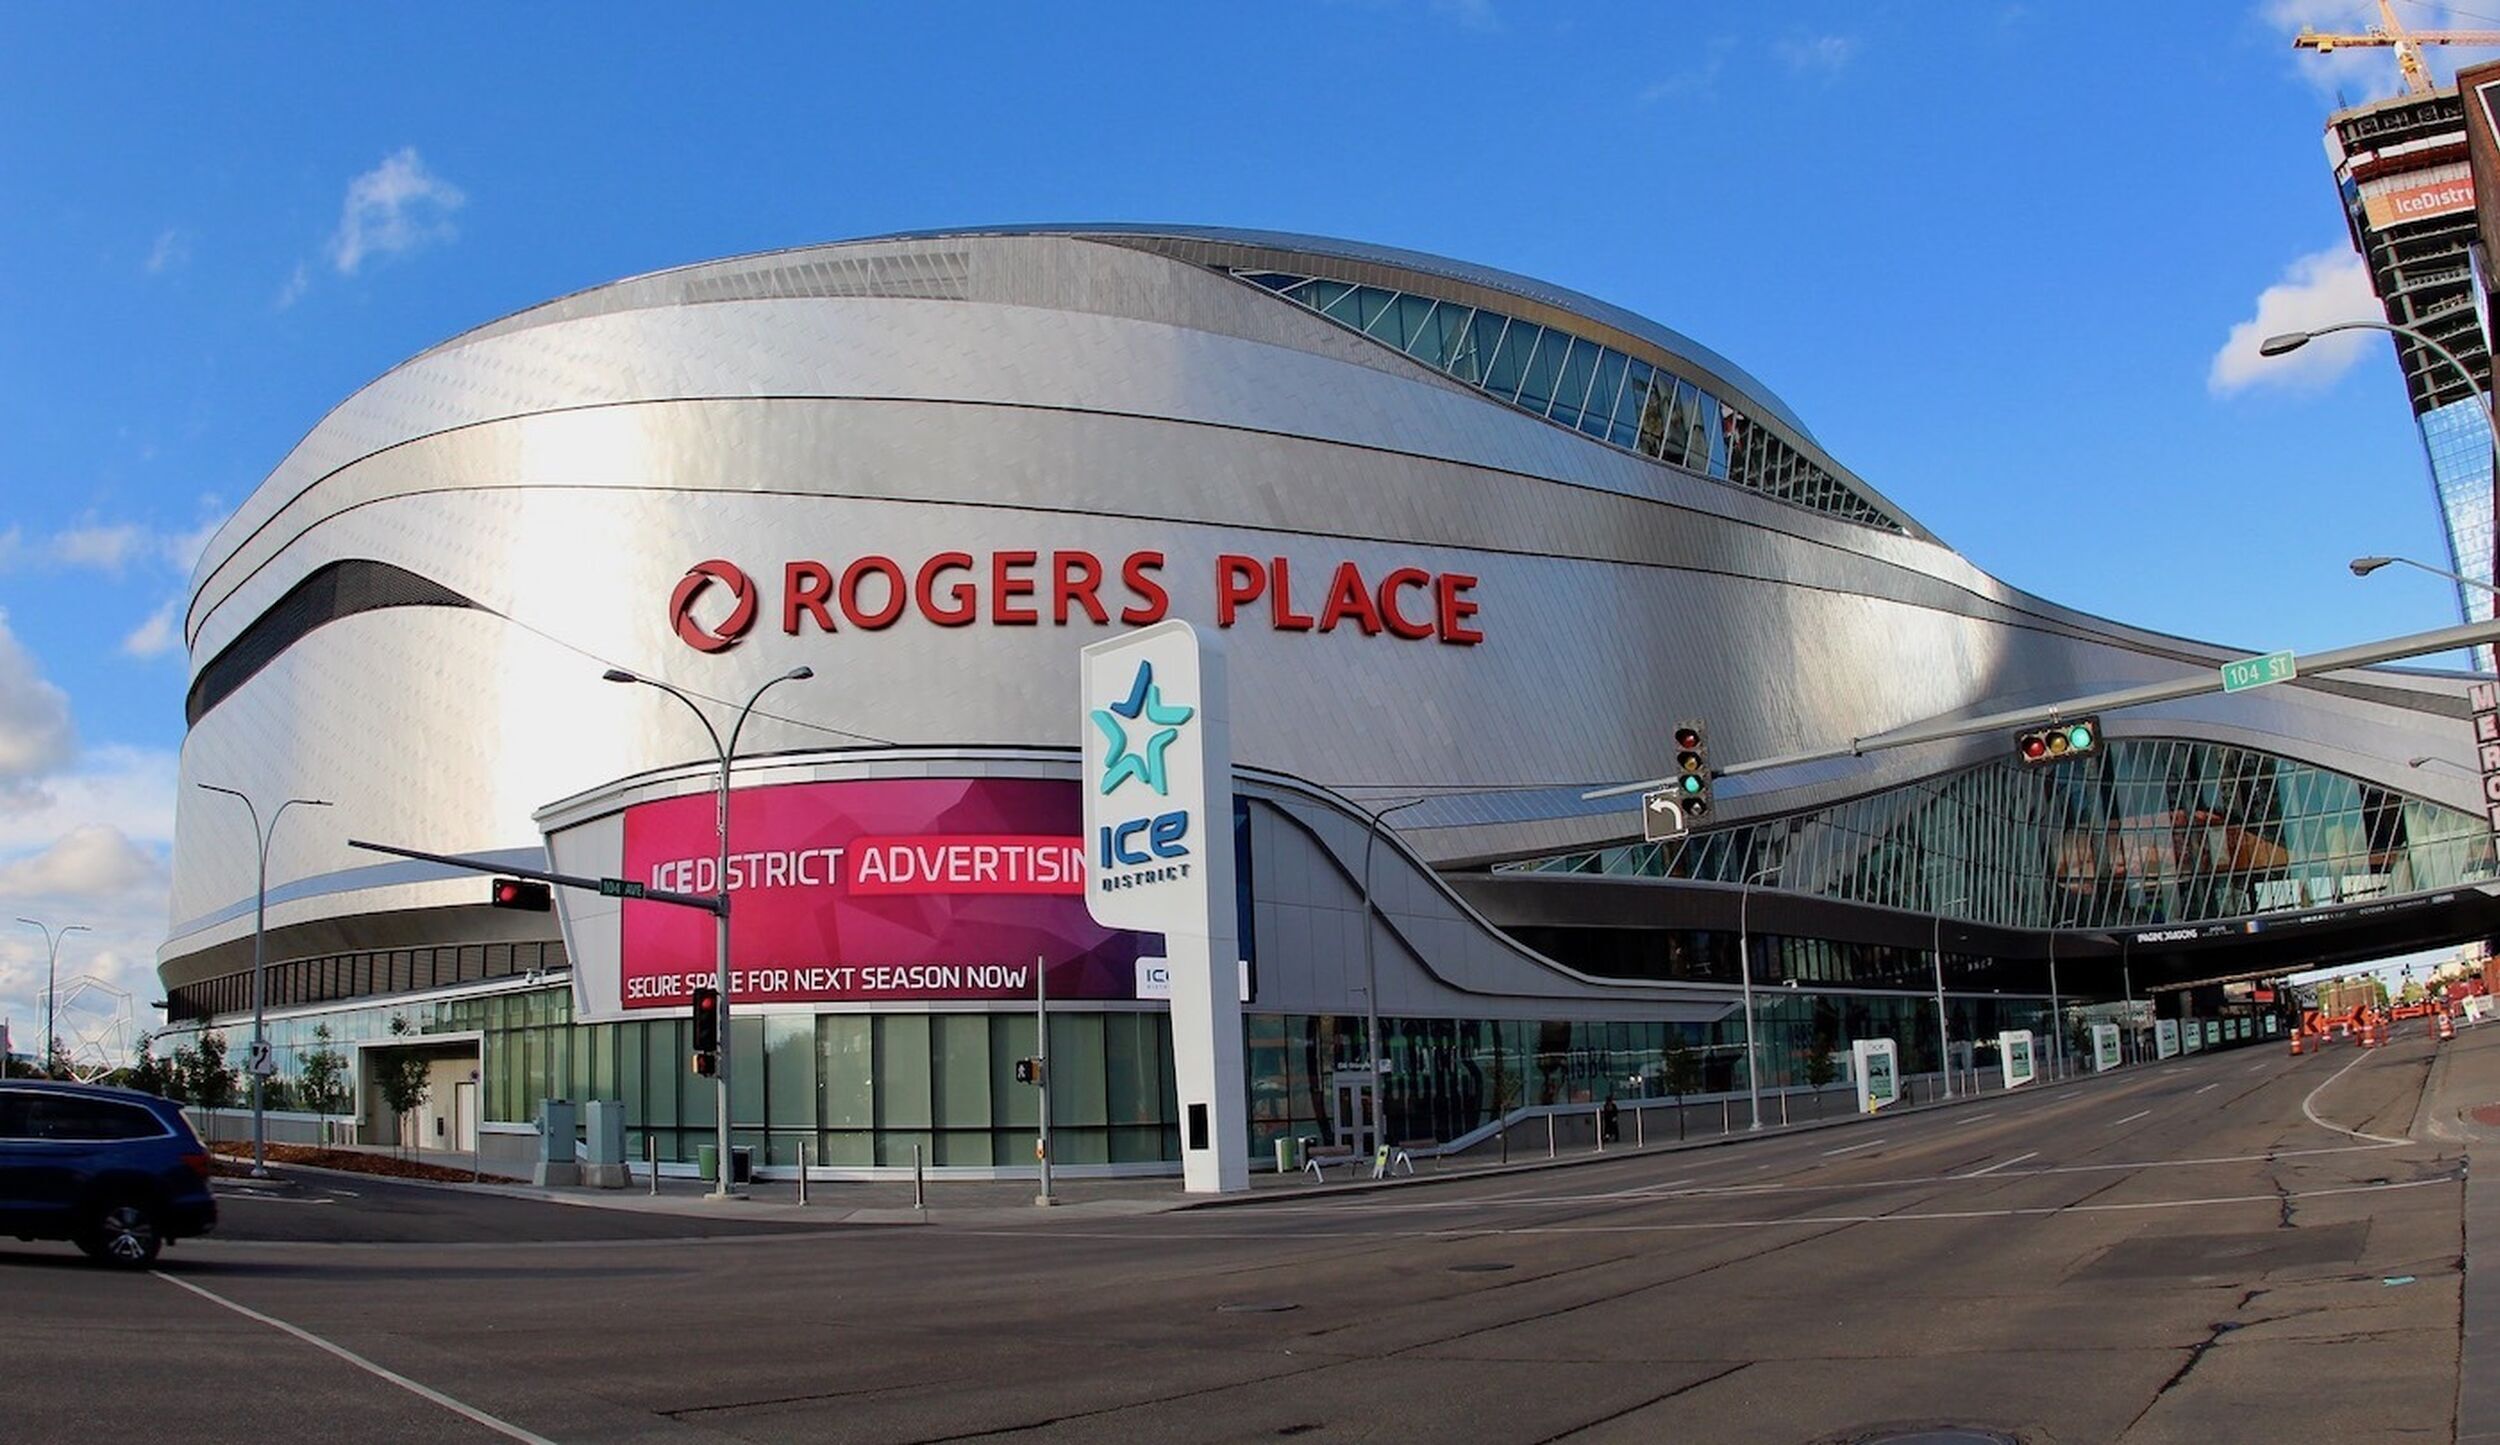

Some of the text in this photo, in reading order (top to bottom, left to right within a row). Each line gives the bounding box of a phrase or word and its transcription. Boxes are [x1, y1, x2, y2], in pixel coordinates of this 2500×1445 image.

[783, 551, 1483, 645] ROGERS PLACE
[2230, 656, 2287, 686] 104 ST
[1102, 863, 1191, 892] DISTRICT
[628, 975, 681, 998] SECURE
[749, 969, 788, 992] FOR
[795, 968, 856, 991] NEXT
[861, 966, 960, 990] SEASON
[967, 966, 1027, 989] NOW
